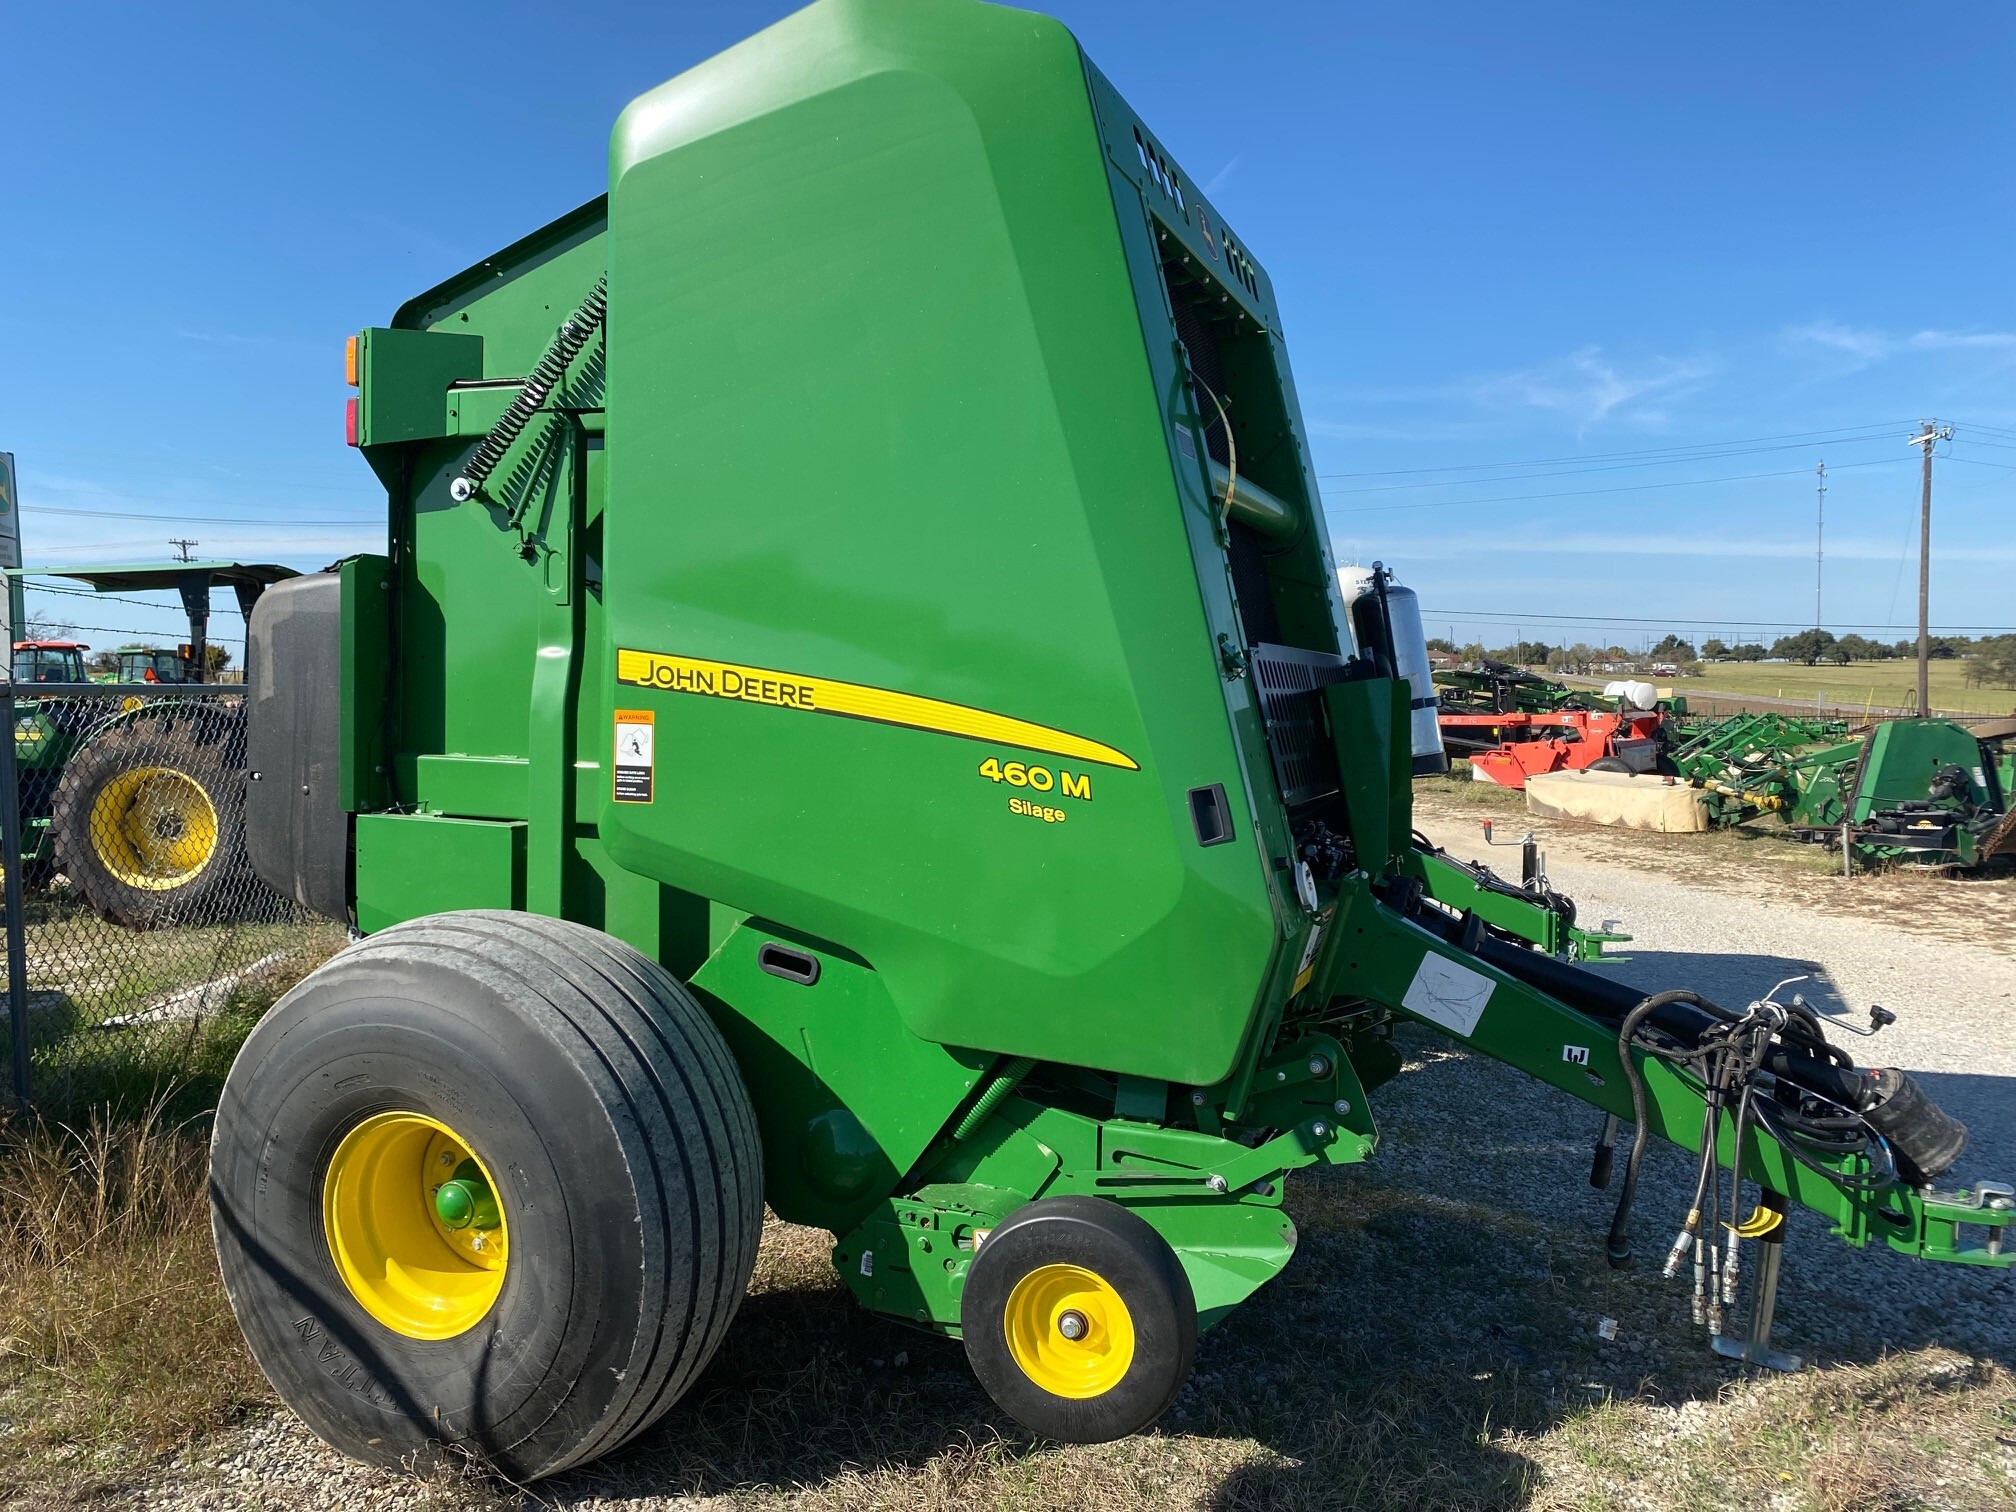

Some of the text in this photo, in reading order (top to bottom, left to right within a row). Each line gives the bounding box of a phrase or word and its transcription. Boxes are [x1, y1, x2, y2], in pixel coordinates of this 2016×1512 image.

[640, 659, 816, 708] JOHN DEERE
[978, 756, 1093, 801] 460 M
[1008, 797, 1066, 823] Silage
